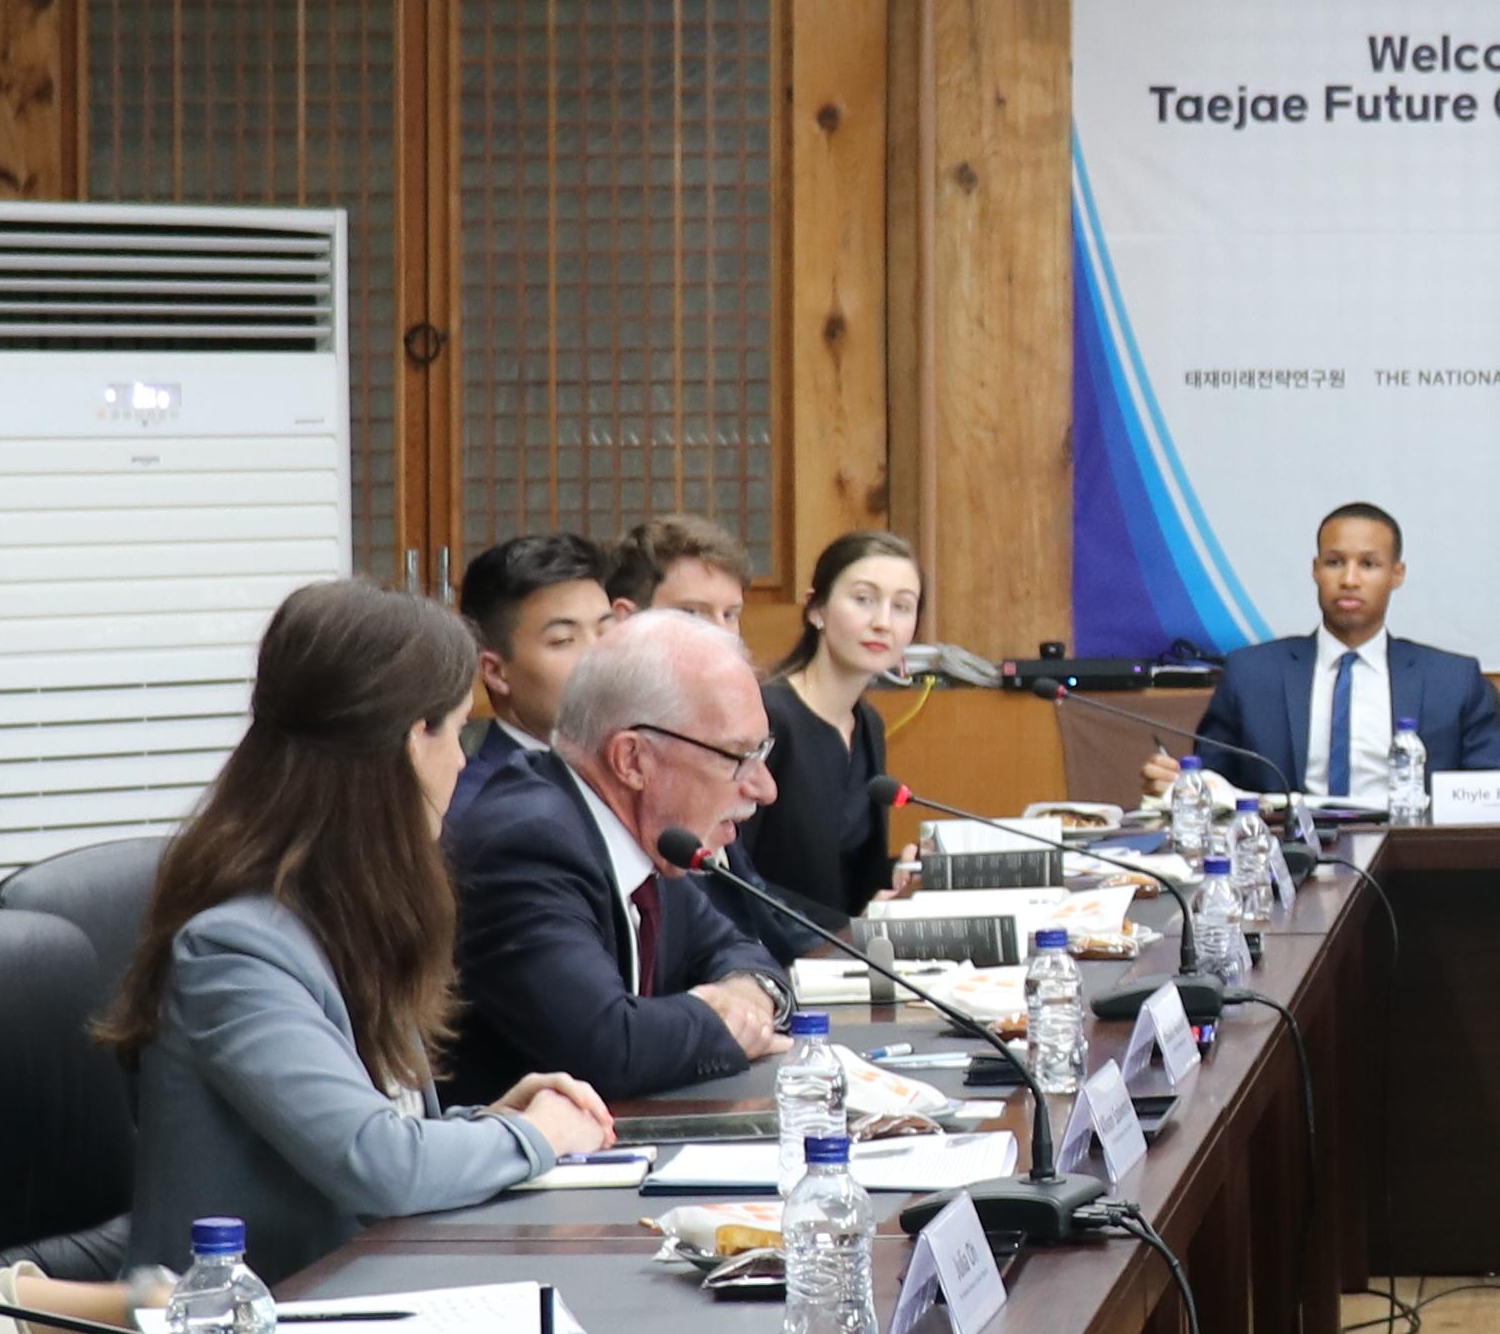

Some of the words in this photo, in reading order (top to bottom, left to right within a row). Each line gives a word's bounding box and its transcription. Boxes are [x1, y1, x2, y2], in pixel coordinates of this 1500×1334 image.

[1148, 84, 1309, 132] Taejae
[1324, 84, 1479, 124] Future
[1184, 368, 1347, 390] 태재미래전략연구원
[1374, 369, 1411, 387] THE
